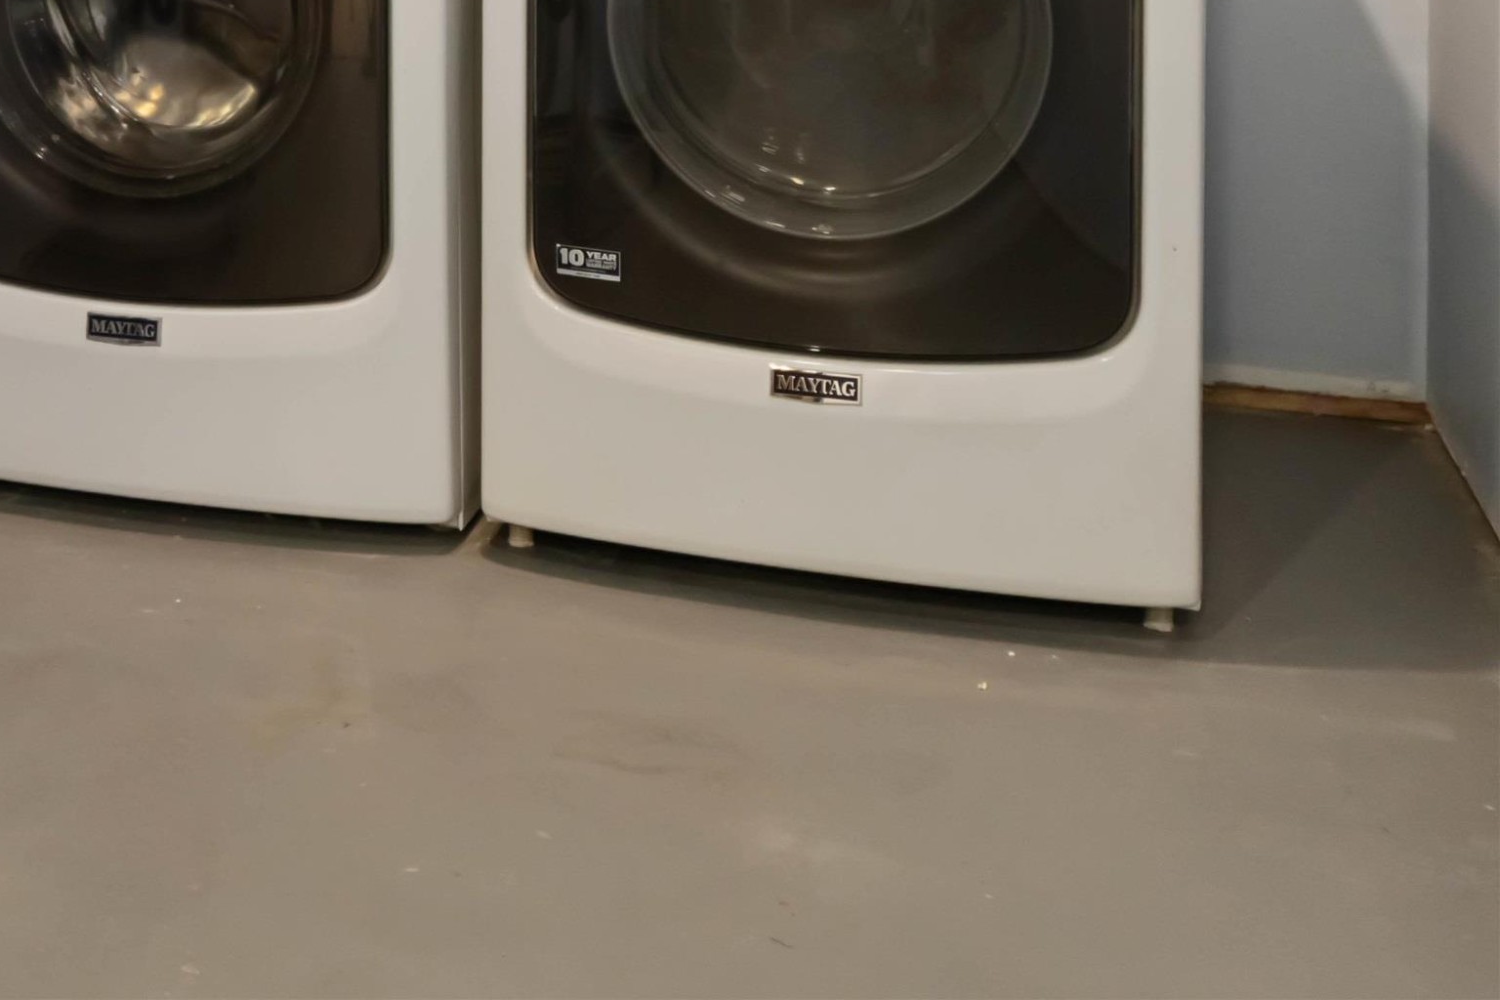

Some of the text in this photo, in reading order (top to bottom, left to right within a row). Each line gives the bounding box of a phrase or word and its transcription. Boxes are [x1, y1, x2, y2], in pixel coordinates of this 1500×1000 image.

[560, 247, 617, 267] 10 YEAR
[91, 318, 156, 338] MAYTAG
[775, 373, 857, 398] MAYTAG
